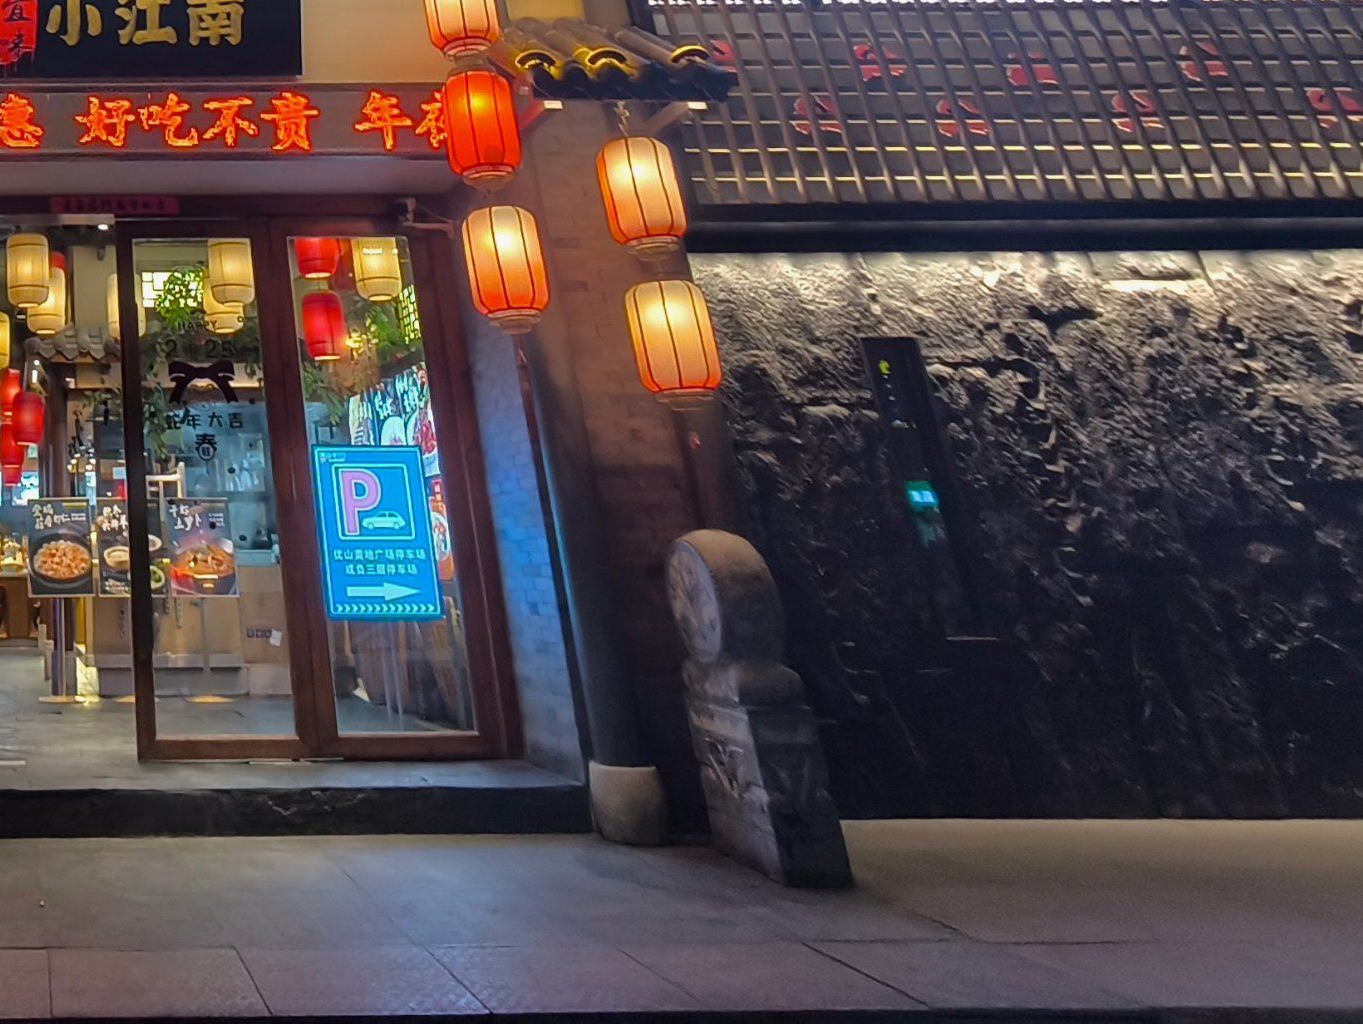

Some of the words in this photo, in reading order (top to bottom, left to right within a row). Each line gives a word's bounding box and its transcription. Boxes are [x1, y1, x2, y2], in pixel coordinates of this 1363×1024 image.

[77, 92, 320, 152] 好吃不贵
[339, 468, 382, 536] P
